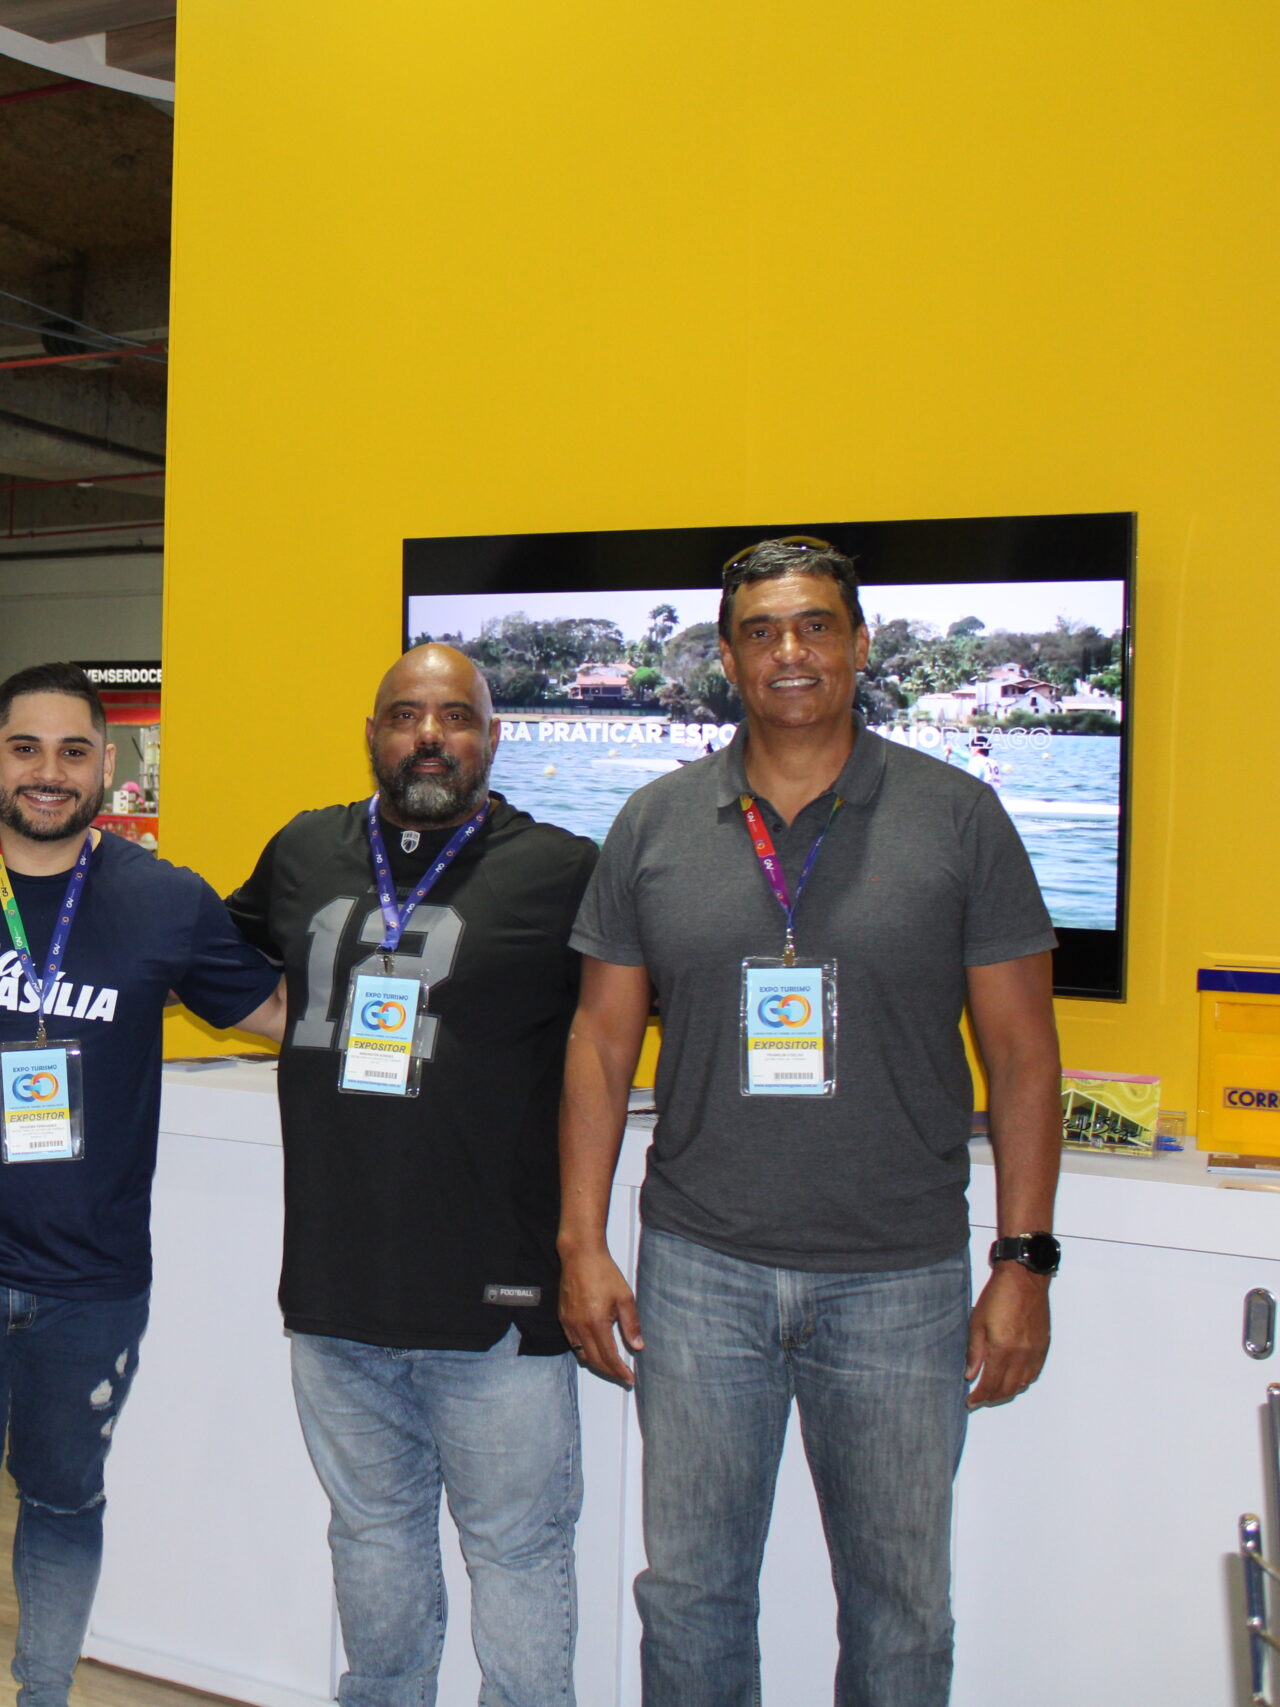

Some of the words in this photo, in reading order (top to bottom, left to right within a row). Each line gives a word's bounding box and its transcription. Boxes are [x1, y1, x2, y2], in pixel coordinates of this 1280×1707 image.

[539, 722, 663, 744] PRATICAR
[973, 727, 1052, 750] LAGO
[780, 985, 811, 993] TURISMO
[365, 991, 382, 999] EXPO
[383, 993, 408, 1001] TURISMO
[353, 1040, 407, 1053] EXPOSITOR
[753, 1041, 818, 1051] EXPOSITOR
[9, 1111, 65, 1123] EXPOSITOR
[500, 1288, 533, 1297] FOOTBALL
